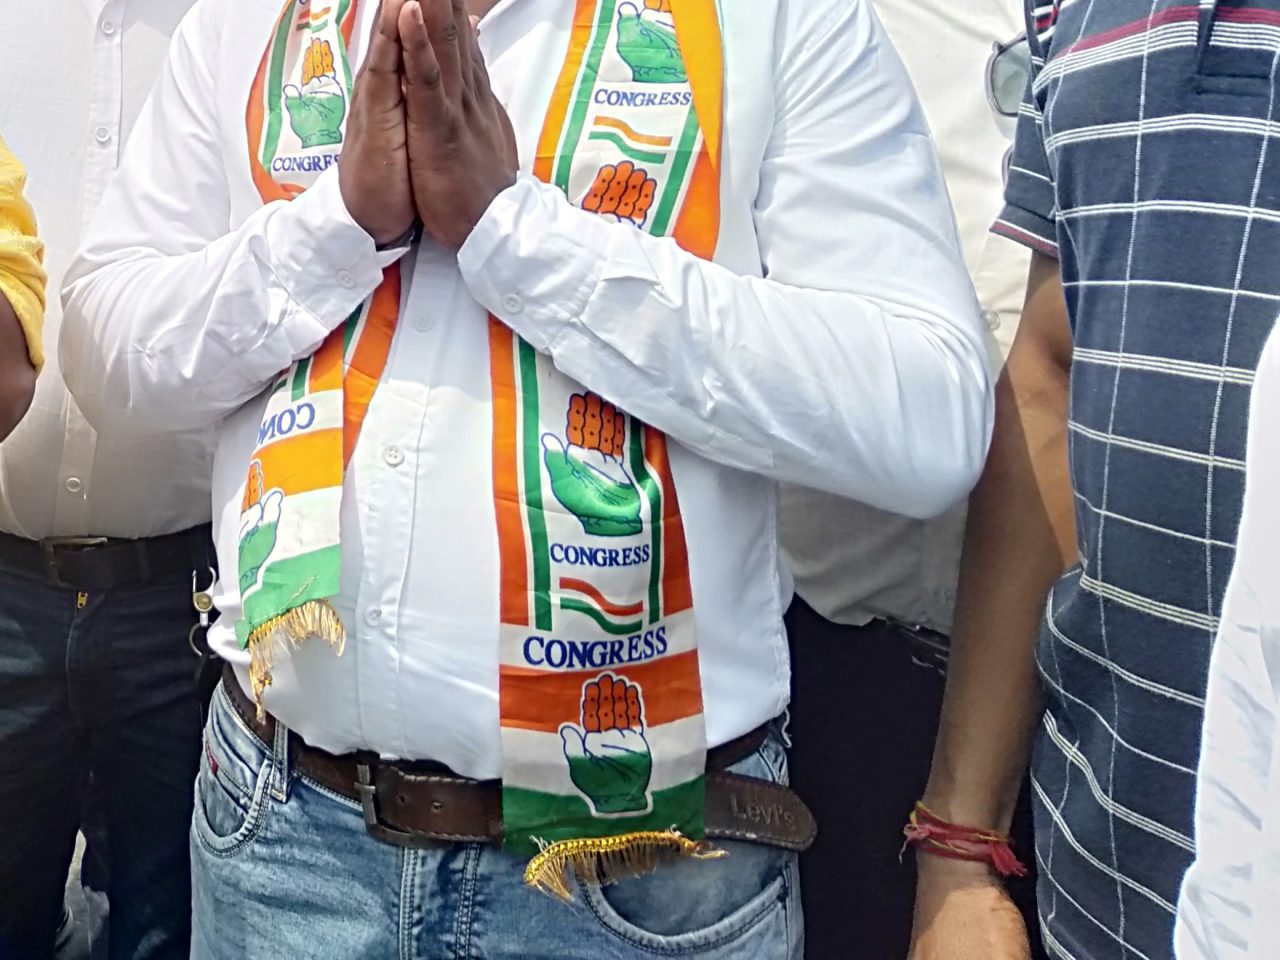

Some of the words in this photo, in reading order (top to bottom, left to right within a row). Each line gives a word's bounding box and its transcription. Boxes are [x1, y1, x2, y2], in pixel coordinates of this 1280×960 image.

[594, 88, 691, 107] CONGRESS
[272, 153, 340, 172] CONGRE
[549, 542, 650, 567] CONGRESS
[522, 625, 668, 669] CONGRESS
